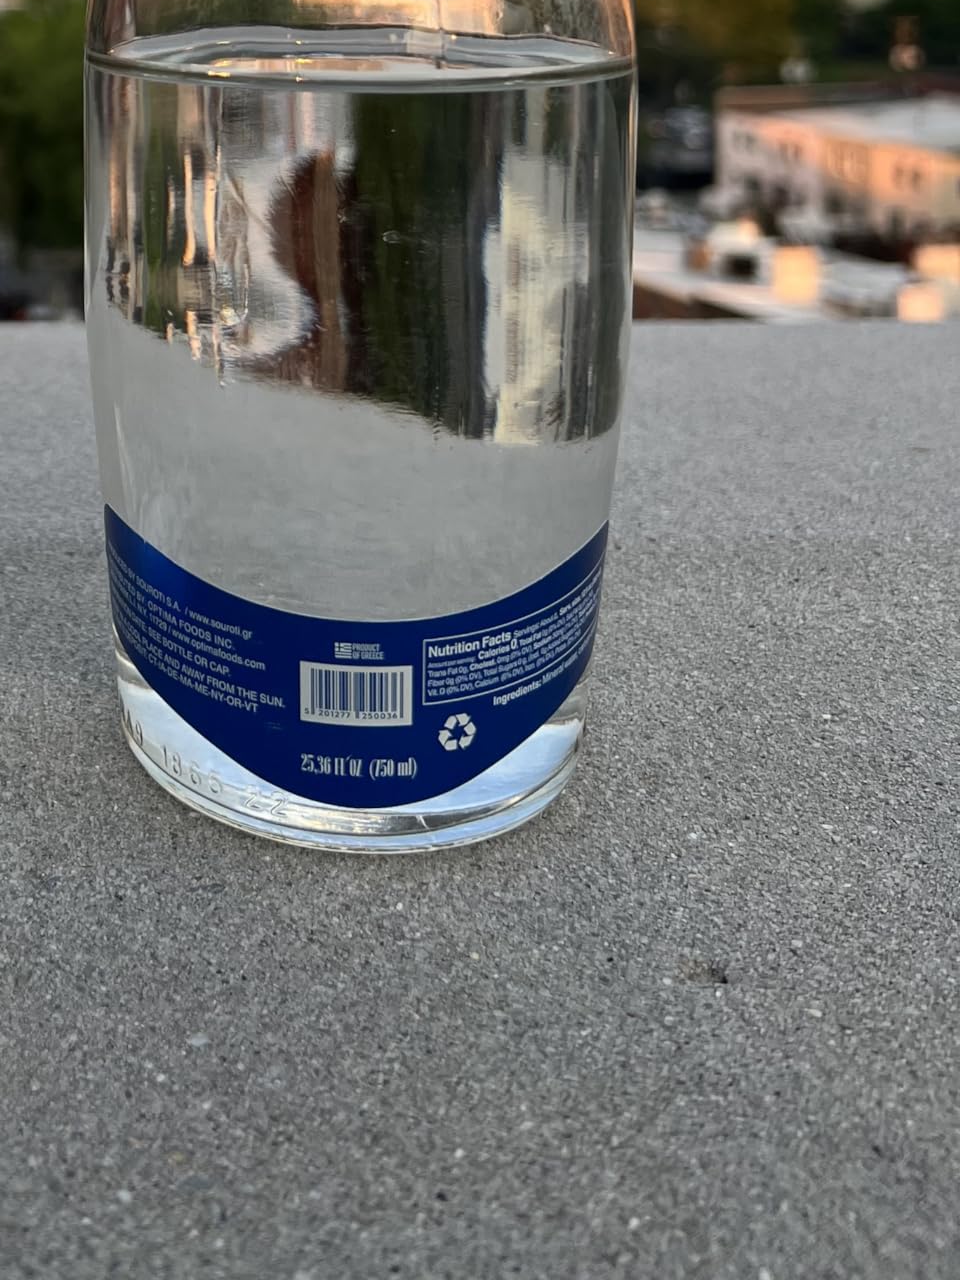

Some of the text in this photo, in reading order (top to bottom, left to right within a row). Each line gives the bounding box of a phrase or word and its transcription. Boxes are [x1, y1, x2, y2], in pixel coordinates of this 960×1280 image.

[148, 600, 177, 626] OPTIMA
[179, 619, 212, 643] FOODS
[214, 634, 236, 651] INC.
[189, 609, 253, 641] www.souroti.gr
[148, 625, 162, 643] SEE
[162, 634, 193, 662] BOTTLE
[194, 654, 208, 669] OR
[209, 661, 231, 678] CAP.
[172, 629, 266, 671] www.optimafoods.com
[352, 642, 380, 651] PRODUCT
[352, 651, 385, 660] OF GREECE
[428, 641, 480, 658] Nutrition
[482, 632, 512, 648] Facts
[478, 644, 510, 659] Calories
[142, 635, 163, 657] PLACE
[164, 652, 181, 670] AND
[182, 663, 205, 683] AWAY
[207, 675, 235, 695] FROM
[237, 686, 258, 702] THE
[259, 693, 286, 708] SUN.
[427, 669, 446, 678] Trans
[447, 666, 458, 675] Fat
[427, 679, 445, 687] Fiber
[493, 679, 542, 706] Ingredients:
[542, 661, 565, 684] Mineral
[427, 688, 439, 697] Vit.
[439, 687, 446, 695] D
[318, 709, 351, 719] 201277
[362, 712, 398, 720] 250036
[369, 758, 395, 781] (750
[397, 757, 417, 780] ml)
